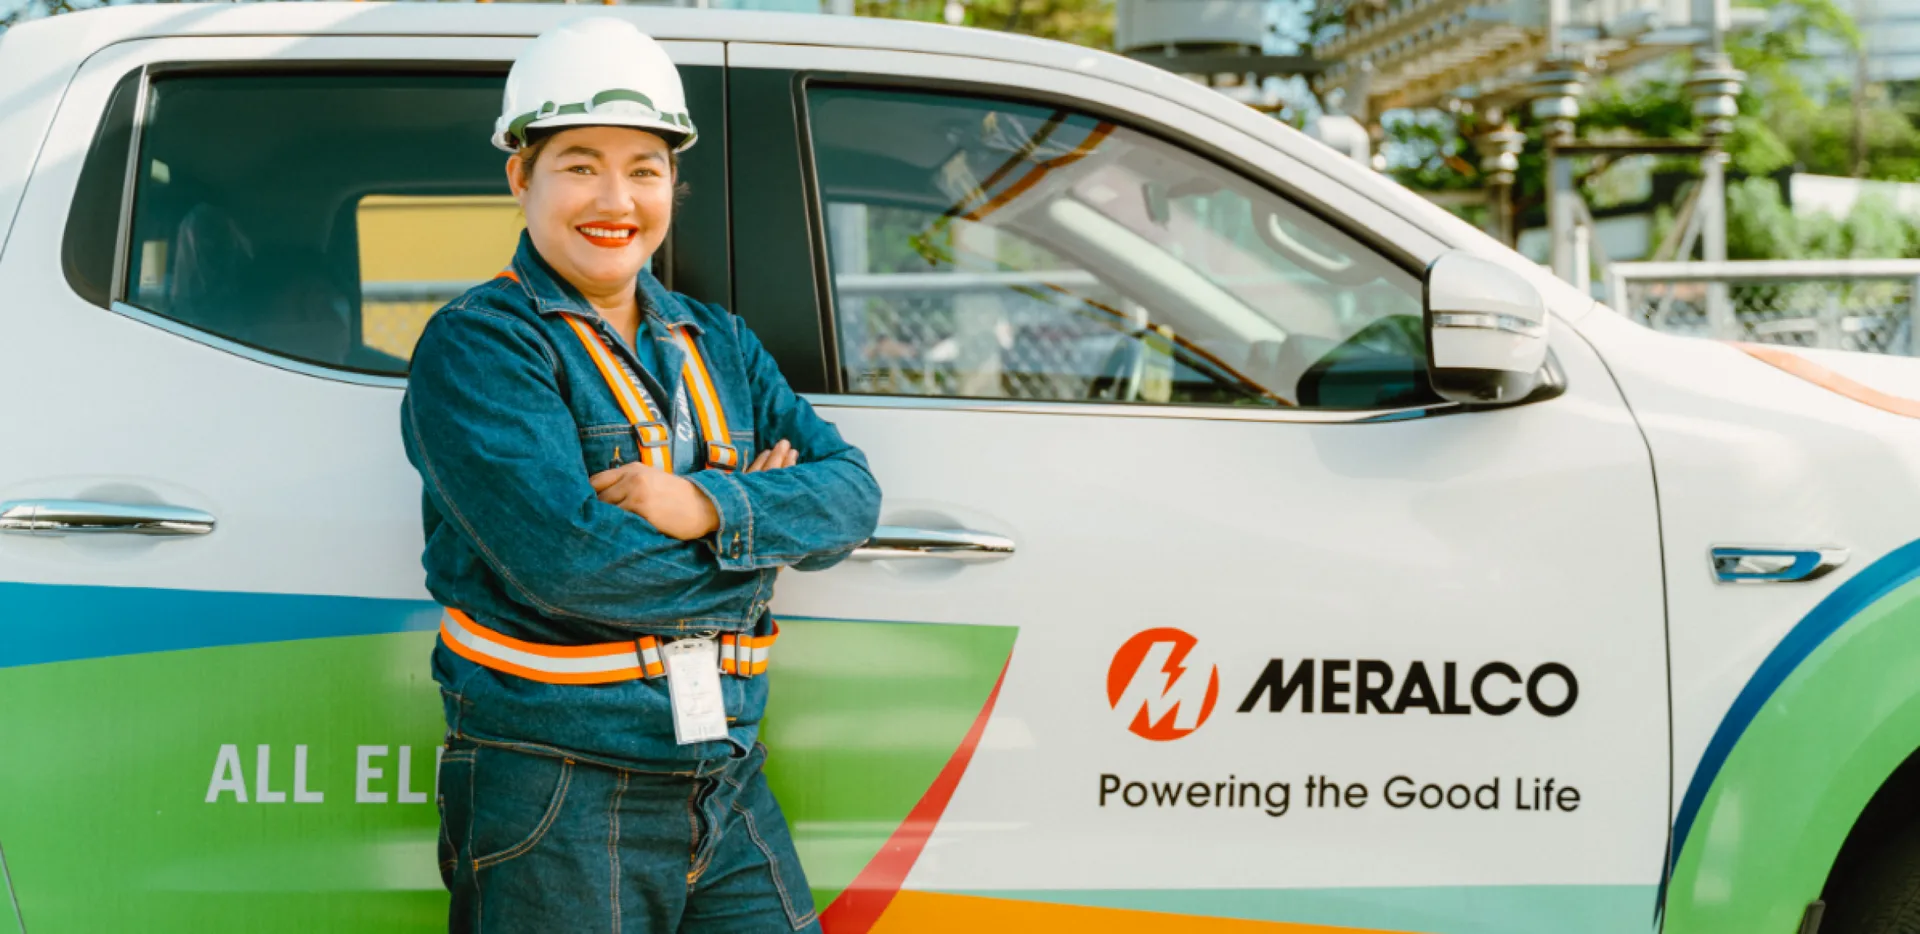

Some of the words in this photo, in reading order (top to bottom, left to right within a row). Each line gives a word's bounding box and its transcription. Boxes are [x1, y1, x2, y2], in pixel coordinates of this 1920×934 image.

[1237, 658, 1579, 717] MERALCO
[205, 744, 324, 803] ALL
[355, 745, 444, 803] EL
[1099, 773, 1290, 817] Powering
[1305, 775, 1369, 809] the
[1383, 775, 1500, 810] Good
[1515, 777, 1581, 812] Life
